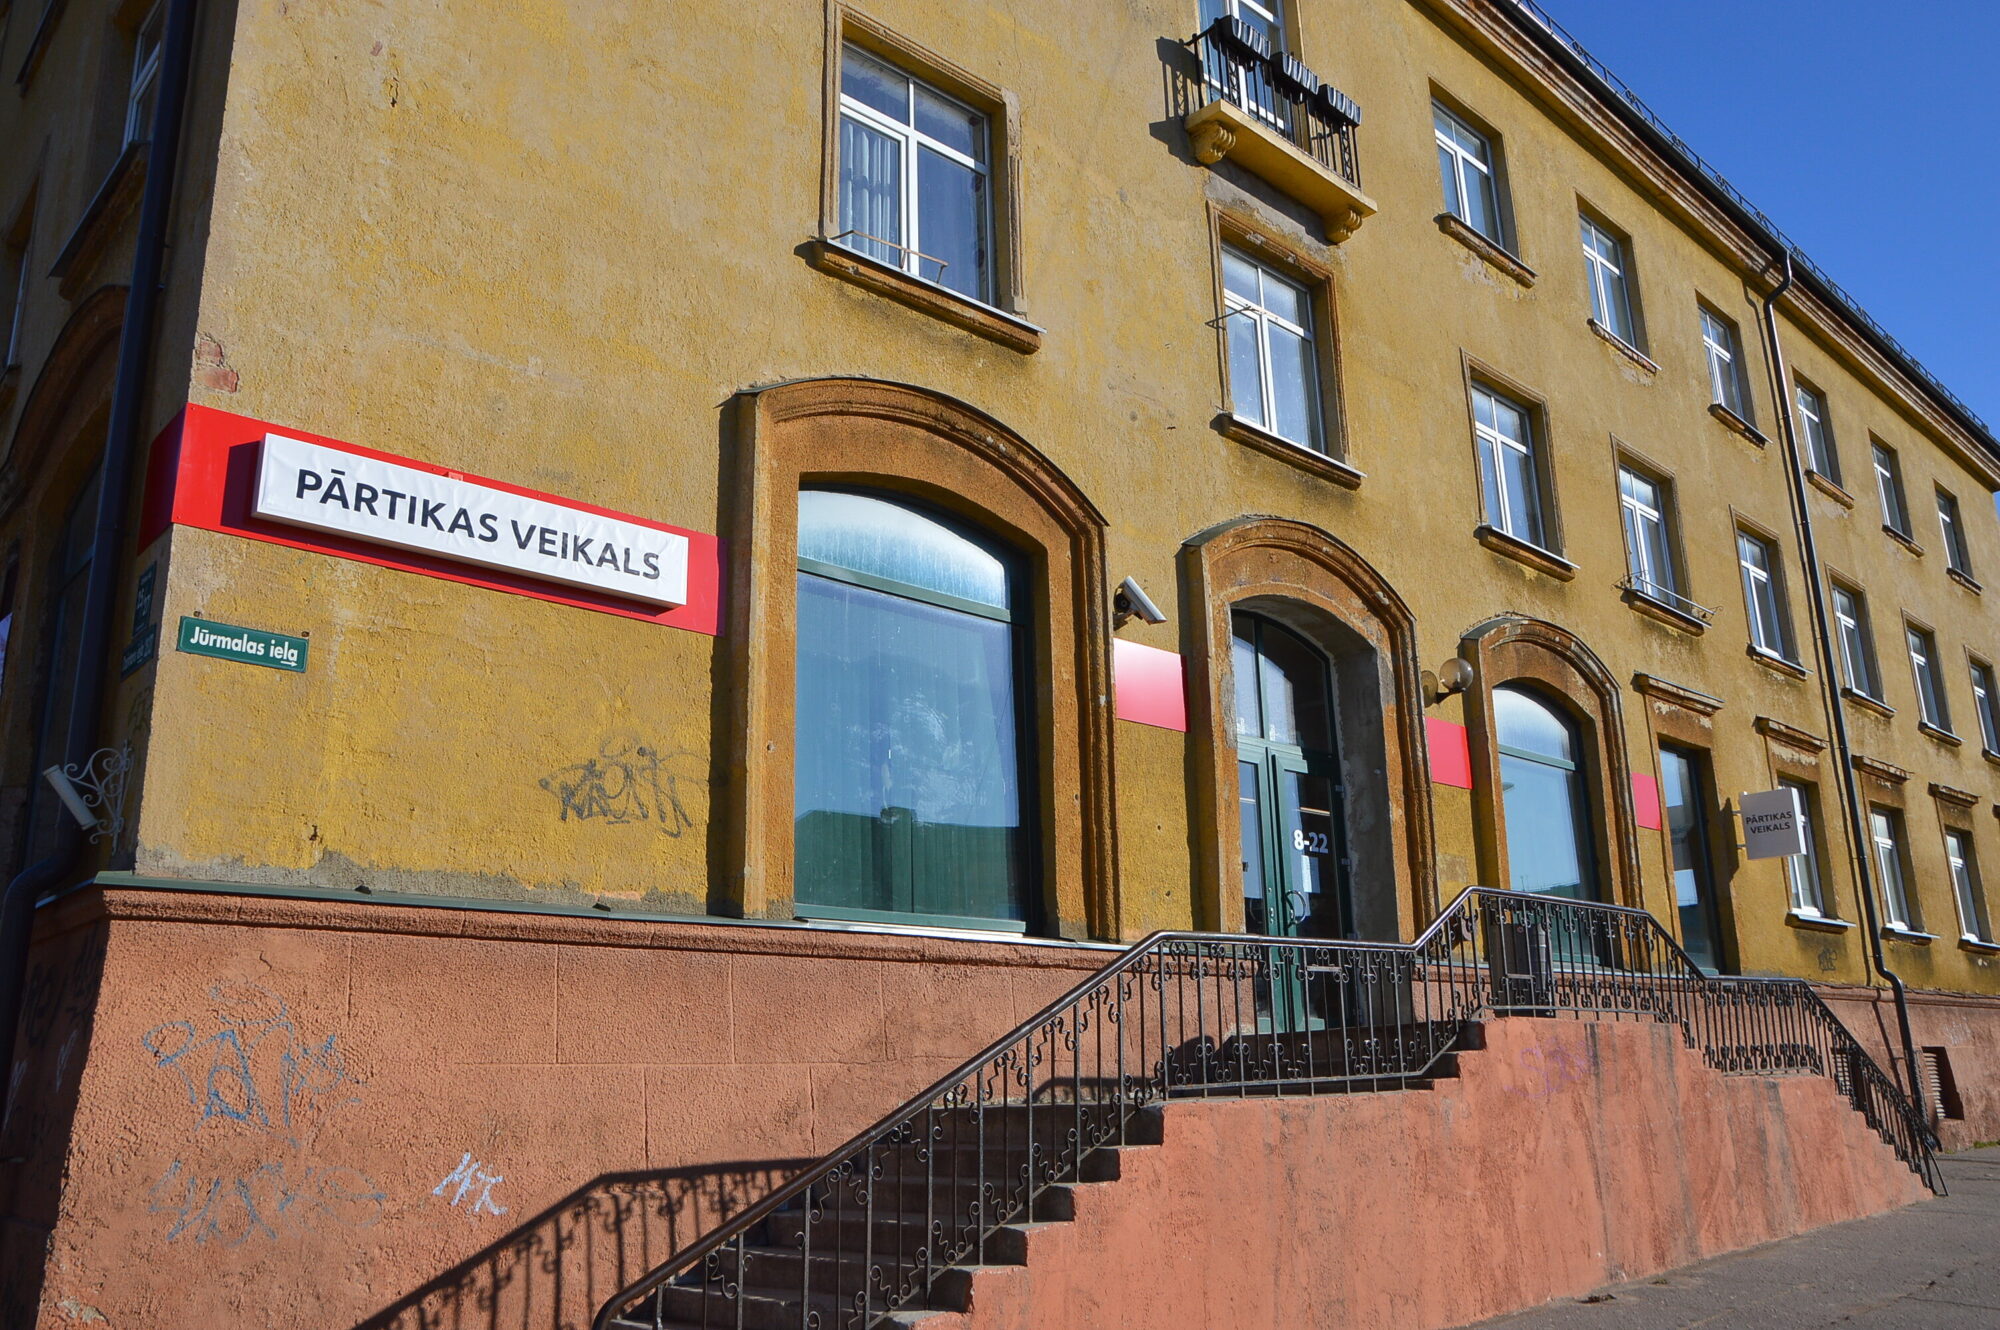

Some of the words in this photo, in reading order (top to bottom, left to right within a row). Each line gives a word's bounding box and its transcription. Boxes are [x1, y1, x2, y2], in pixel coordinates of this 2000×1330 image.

[295, 468, 499, 543] PĀRTIKAS
[510, 519, 661, 580] VEIKALS
[190, 626, 265, 656] Jūrmalas
[269, 639, 298, 662] iela
[1745, 811, 1792, 825] PĀRTIKAS
[1750, 822, 1791, 834] VEIKALS
[1293, 829, 1329, 854] 8-22
